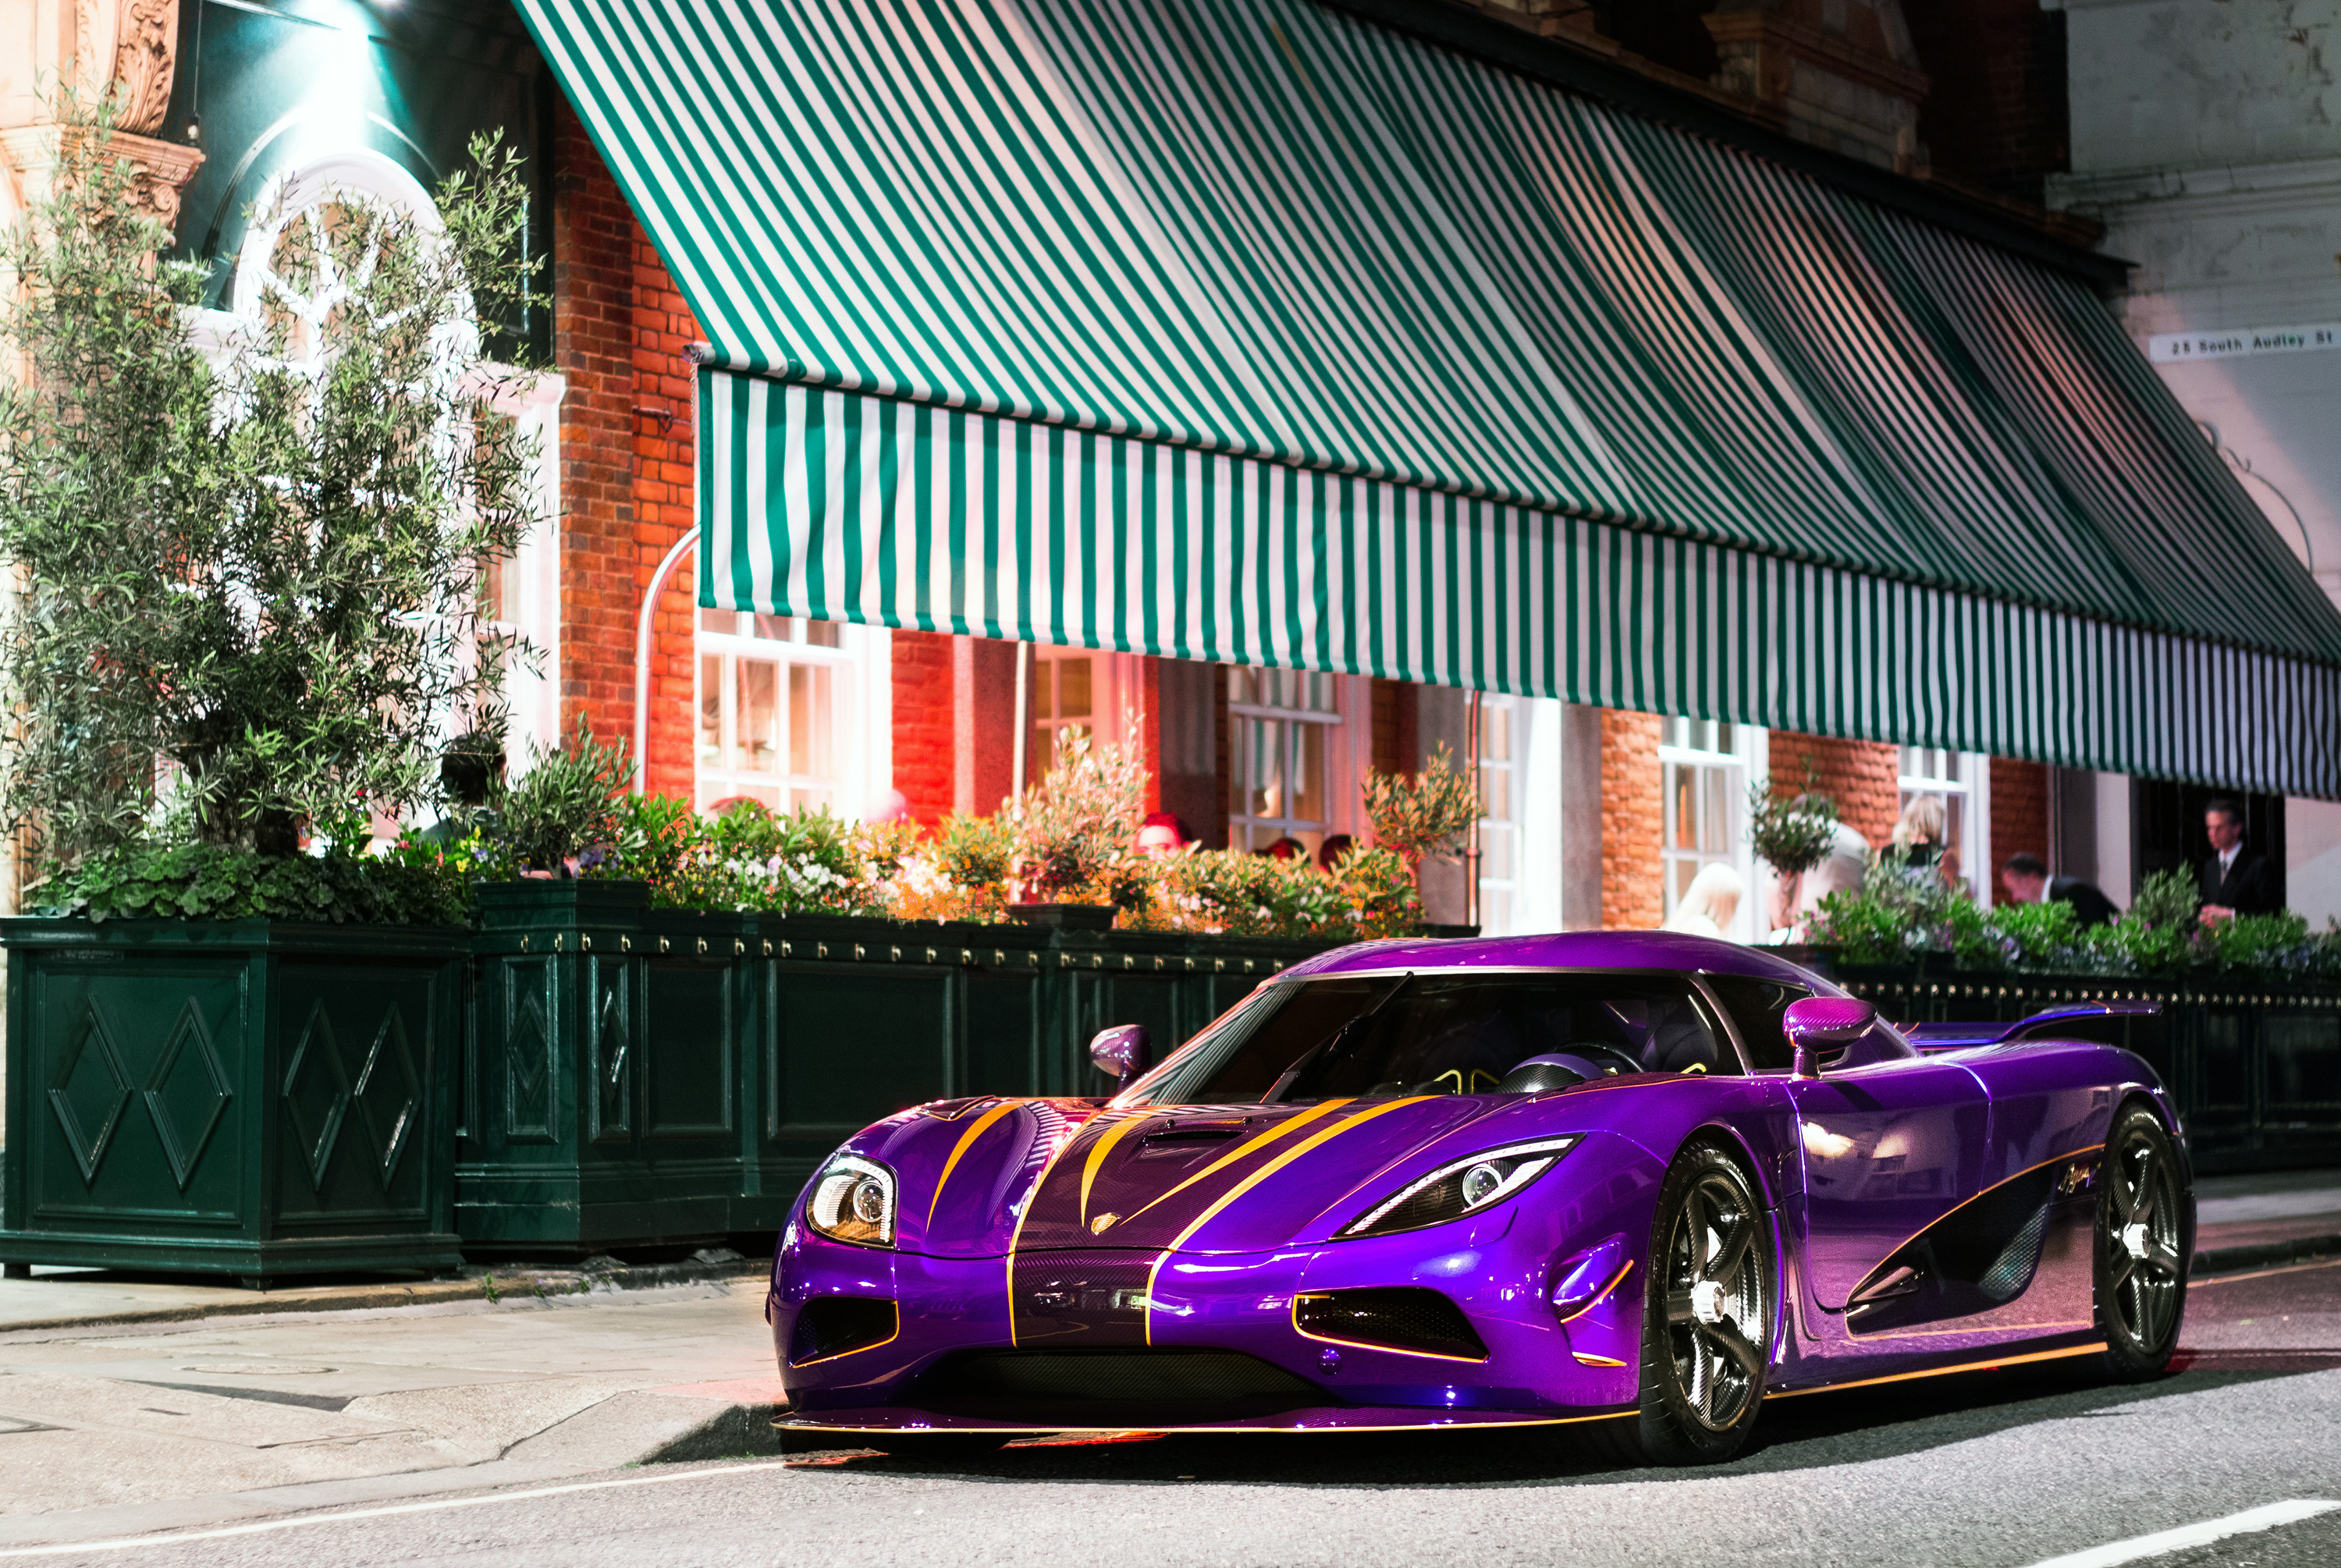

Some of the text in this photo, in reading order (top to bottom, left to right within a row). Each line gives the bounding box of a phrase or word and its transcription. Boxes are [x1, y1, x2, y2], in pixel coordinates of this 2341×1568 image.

[2199, 338, 2242, 353] South
[2253, 333, 2304, 349] Audley
[2315, 329, 2332, 345] St
